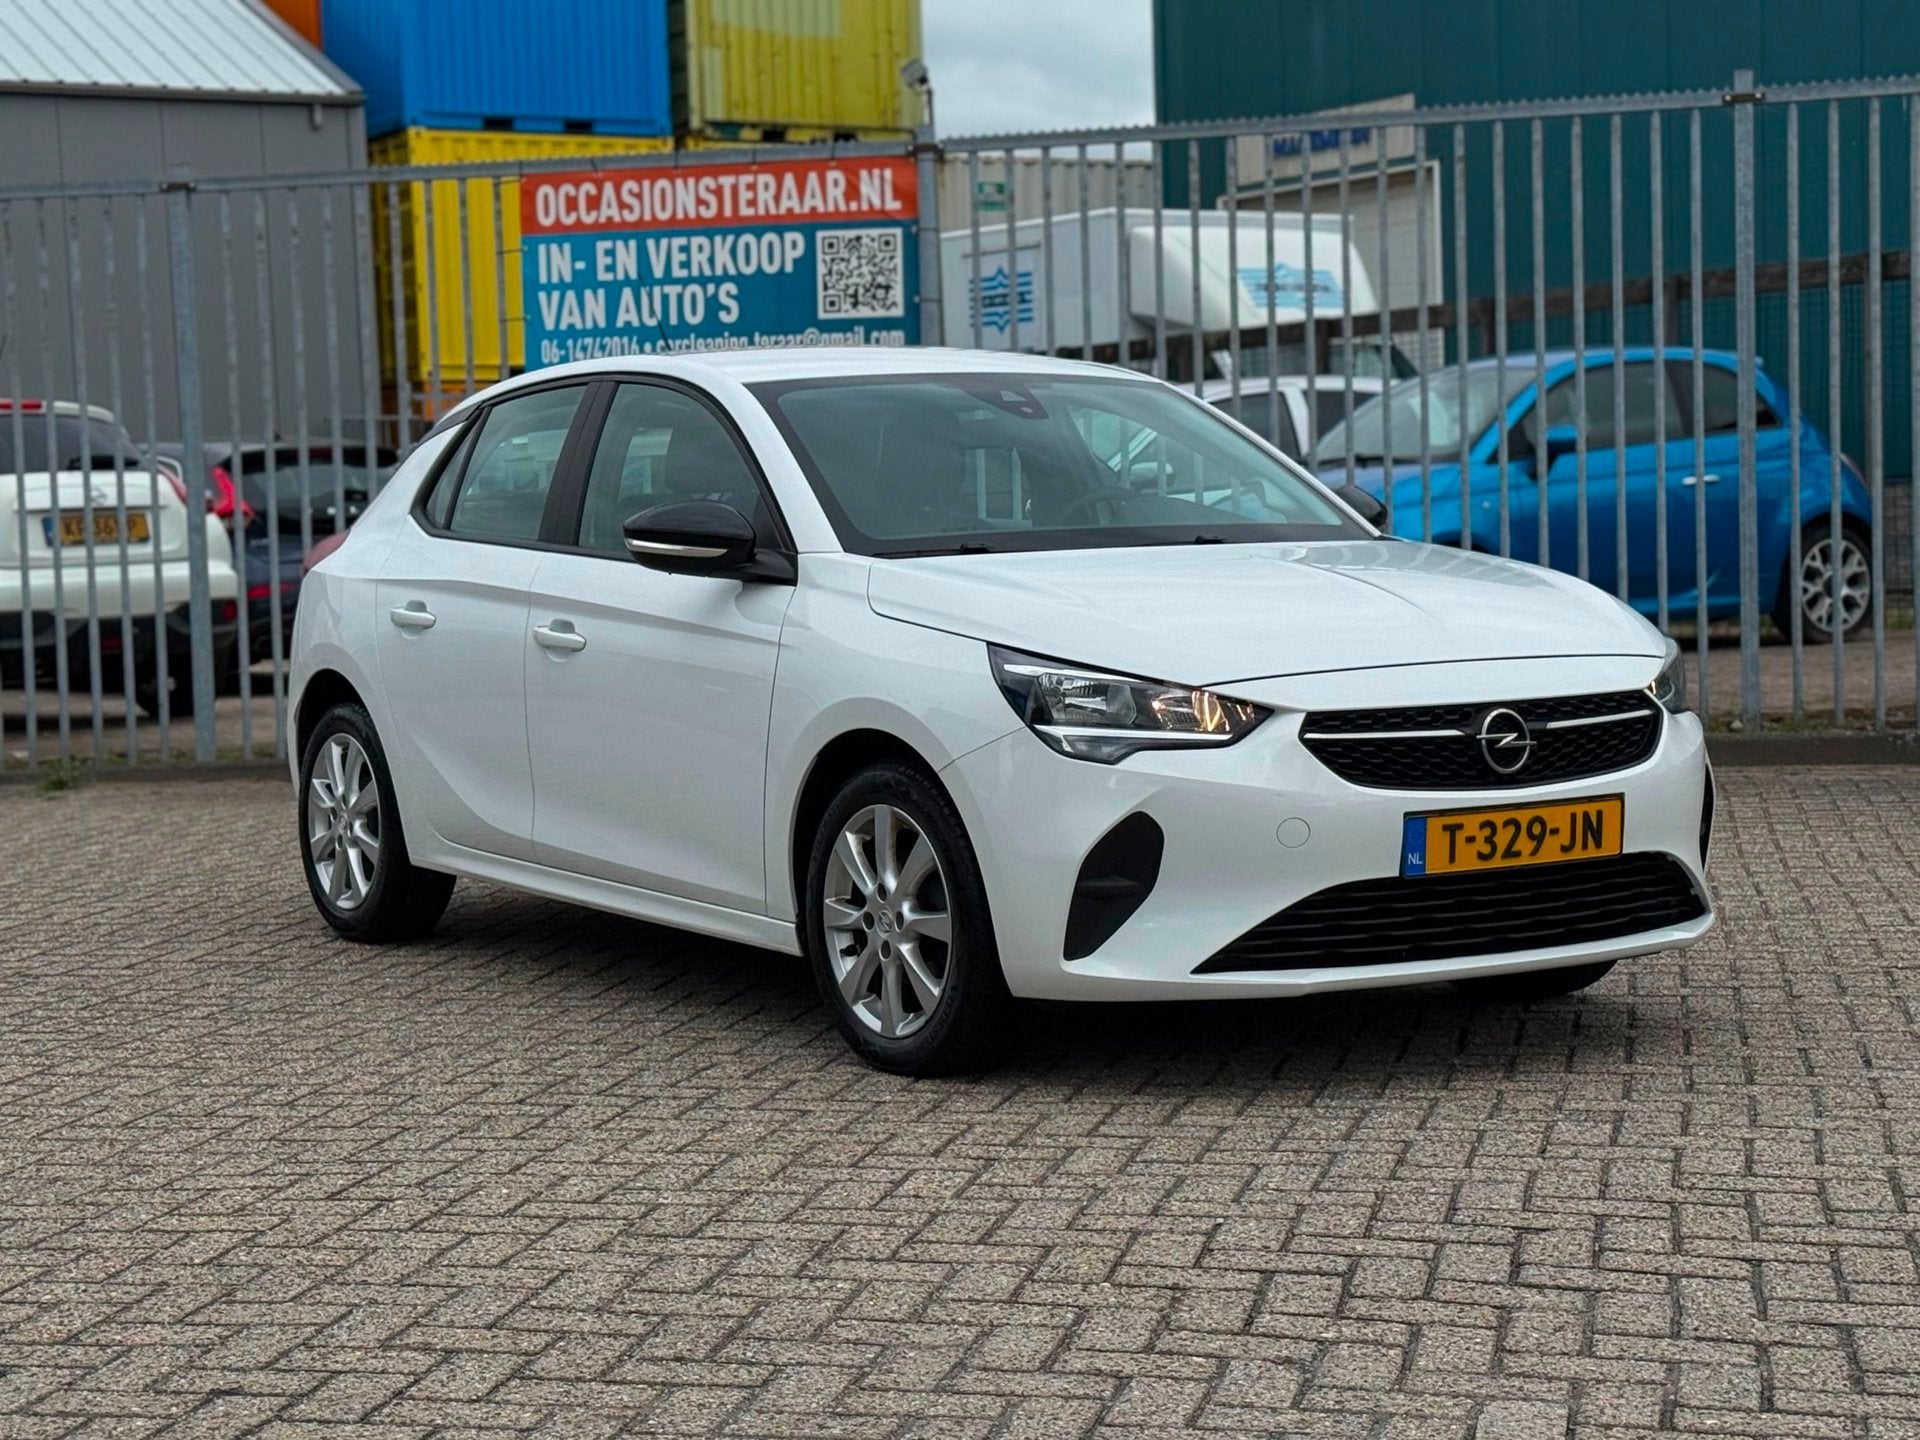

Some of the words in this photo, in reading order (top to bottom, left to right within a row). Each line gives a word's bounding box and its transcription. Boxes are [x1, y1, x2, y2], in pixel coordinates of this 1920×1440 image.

[535, 168, 901, 227] OCCASIONSTERAAR.NL
[537, 243, 586, 284] IN-
[599, 239, 638, 281] EN
[646, 232, 805, 279] VERKOOP
[537, 289, 605, 331] VAN
[616, 282, 739, 329] AUTO'S
[540, 335, 640, 364] 06-14742016
[1408, 852, 1423, 865] NL
[1441, 809, 1604, 864] T-329-JN
